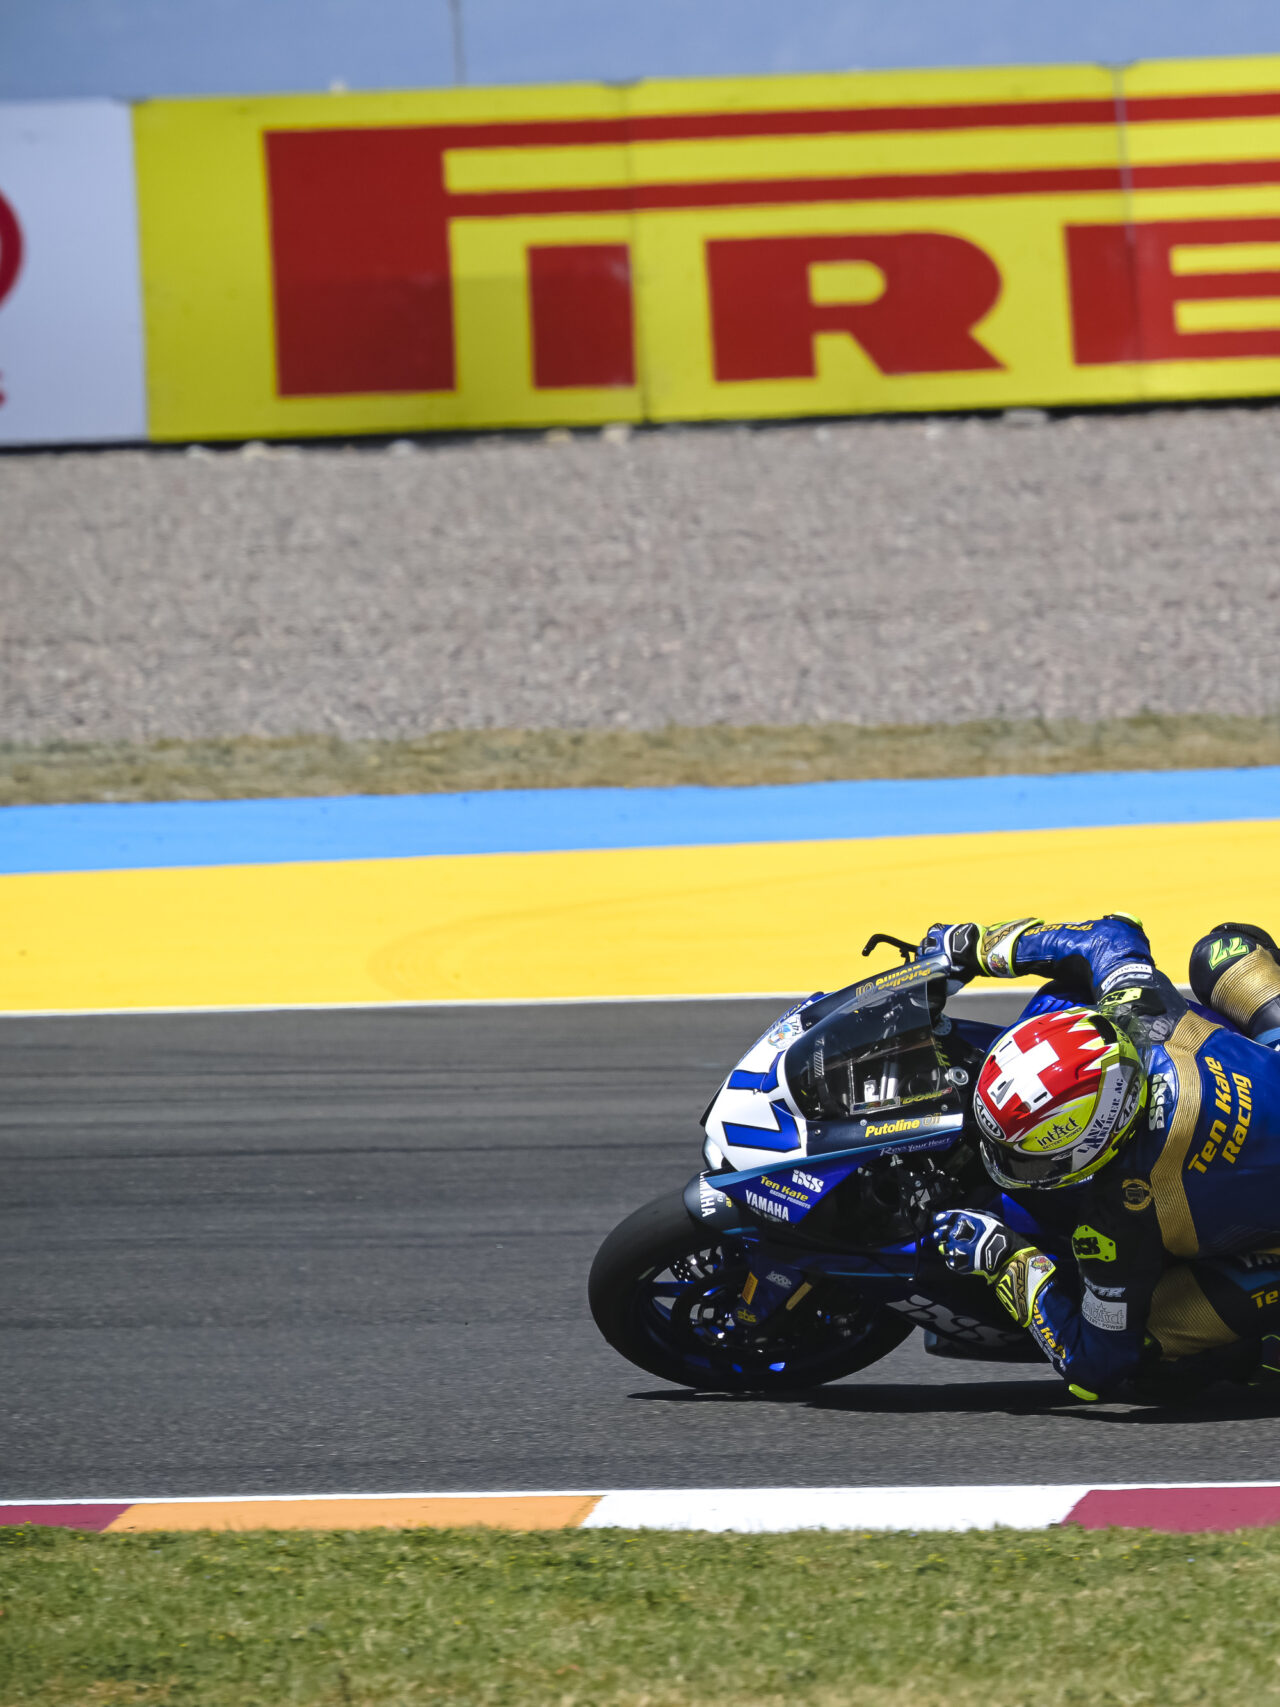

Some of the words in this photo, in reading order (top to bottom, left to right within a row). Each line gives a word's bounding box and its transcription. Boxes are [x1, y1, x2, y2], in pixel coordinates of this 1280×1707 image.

[1208, 937, 1250, 971] 77
[1204, 1056, 1232, 1115] Kate
[864, 1117, 920, 1138] Putoline
[1221, 1072, 1253, 1164] Racing
[1187, 1119, 1227, 1174] Ten
[745, 1189, 790, 1221] YAMAHA
[760, 1175, 780, 1191] Ten
[781, 1184, 809, 1202] Kate
